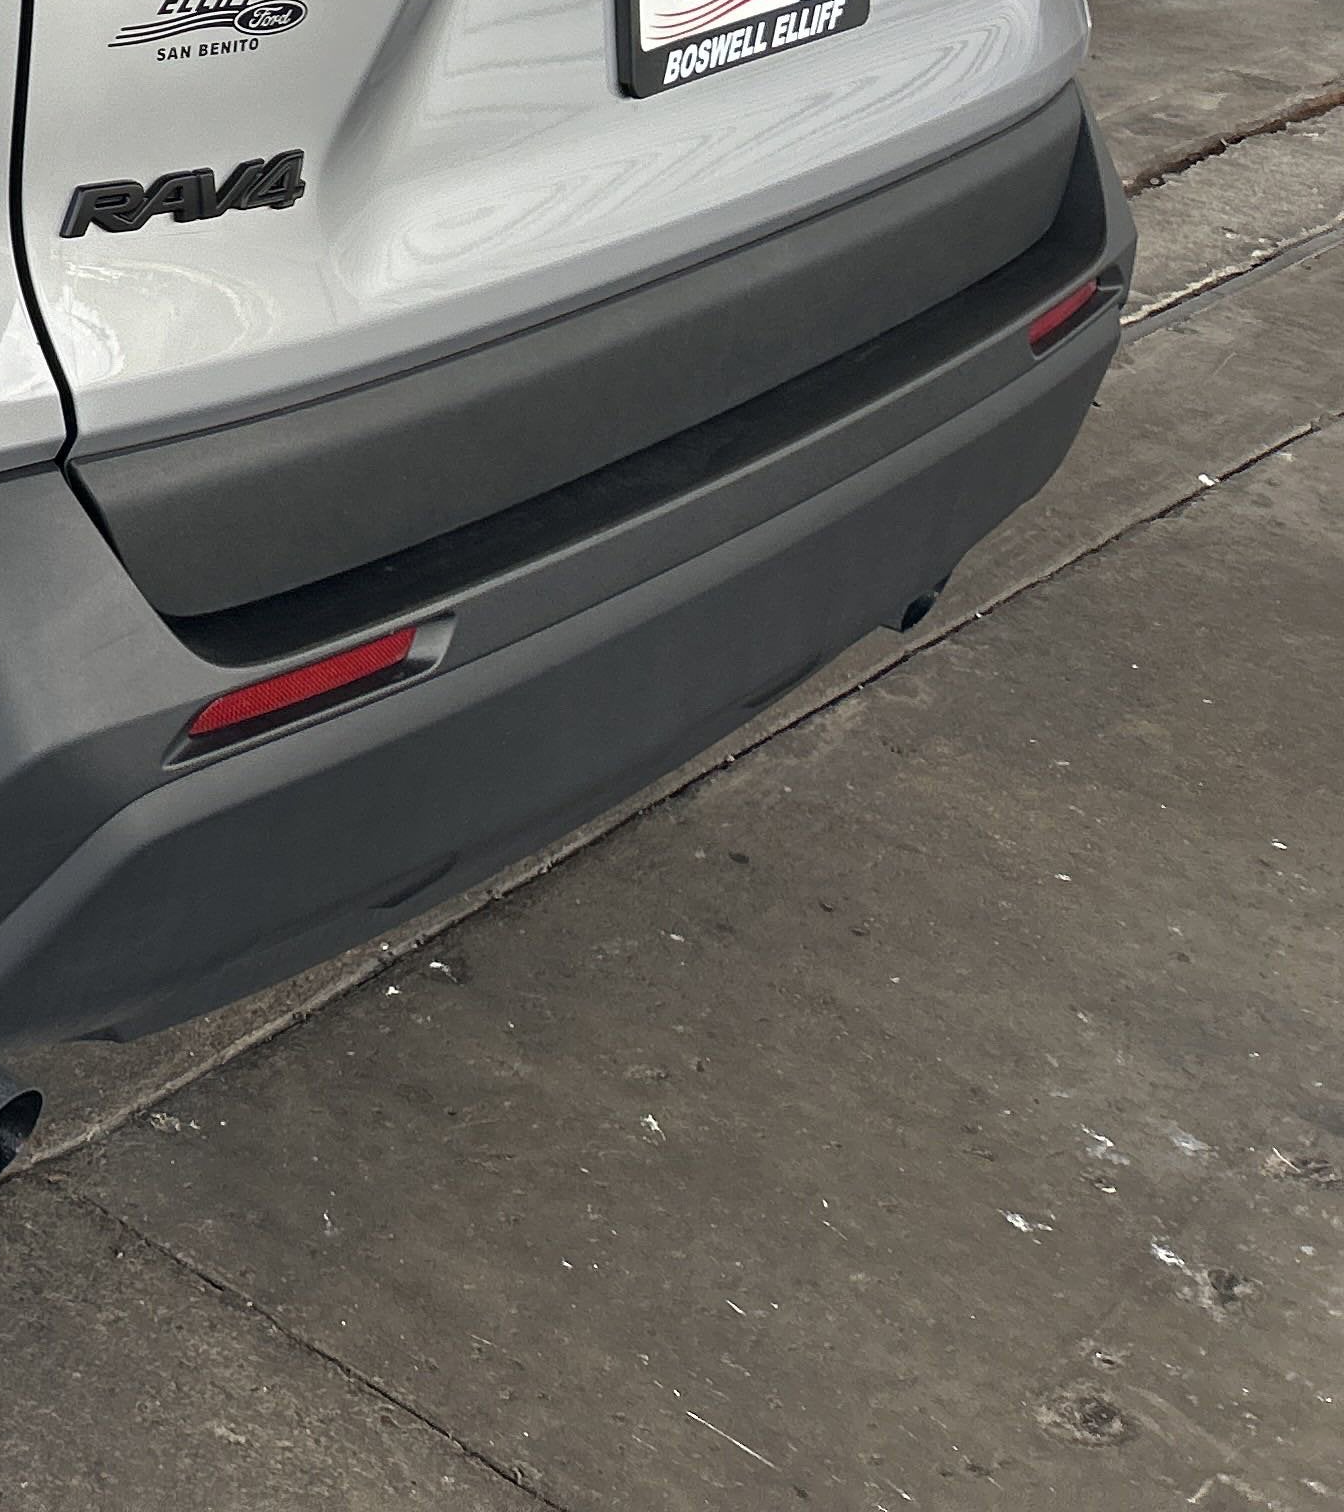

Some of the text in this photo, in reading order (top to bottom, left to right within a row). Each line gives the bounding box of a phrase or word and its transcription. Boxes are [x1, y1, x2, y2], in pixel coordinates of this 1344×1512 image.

[248, 7, 290, 28] Ford
[156, 37, 259, 61] SAN BENITO
[664, 19, 767, 85] BOSWELL
[59, 148, 306, 239] RAV4
